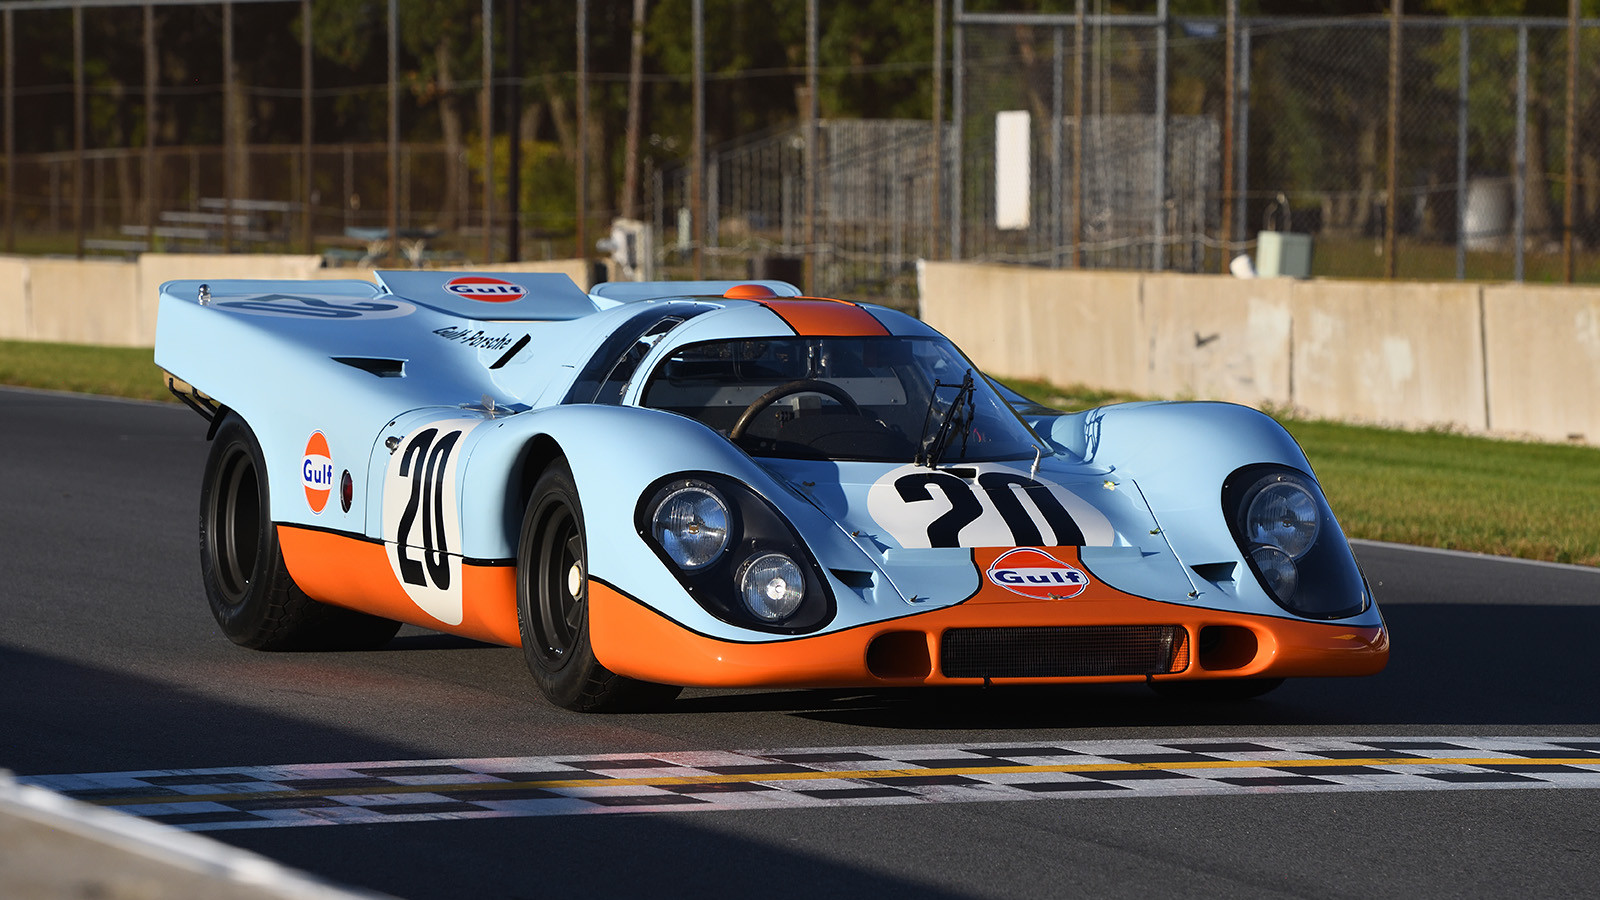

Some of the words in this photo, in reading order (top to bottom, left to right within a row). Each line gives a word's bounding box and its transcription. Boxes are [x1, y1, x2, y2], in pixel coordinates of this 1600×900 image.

[449, 285, 522, 294] Gulf
[432, 325, 512, 351] Gulf-Porsche
[303, 459, 332, 484] Gulf
[397, 427, 462, 591] 20
[894, 472, 1086, 548] 20
[994, 570, 1082, 584] Gulf
